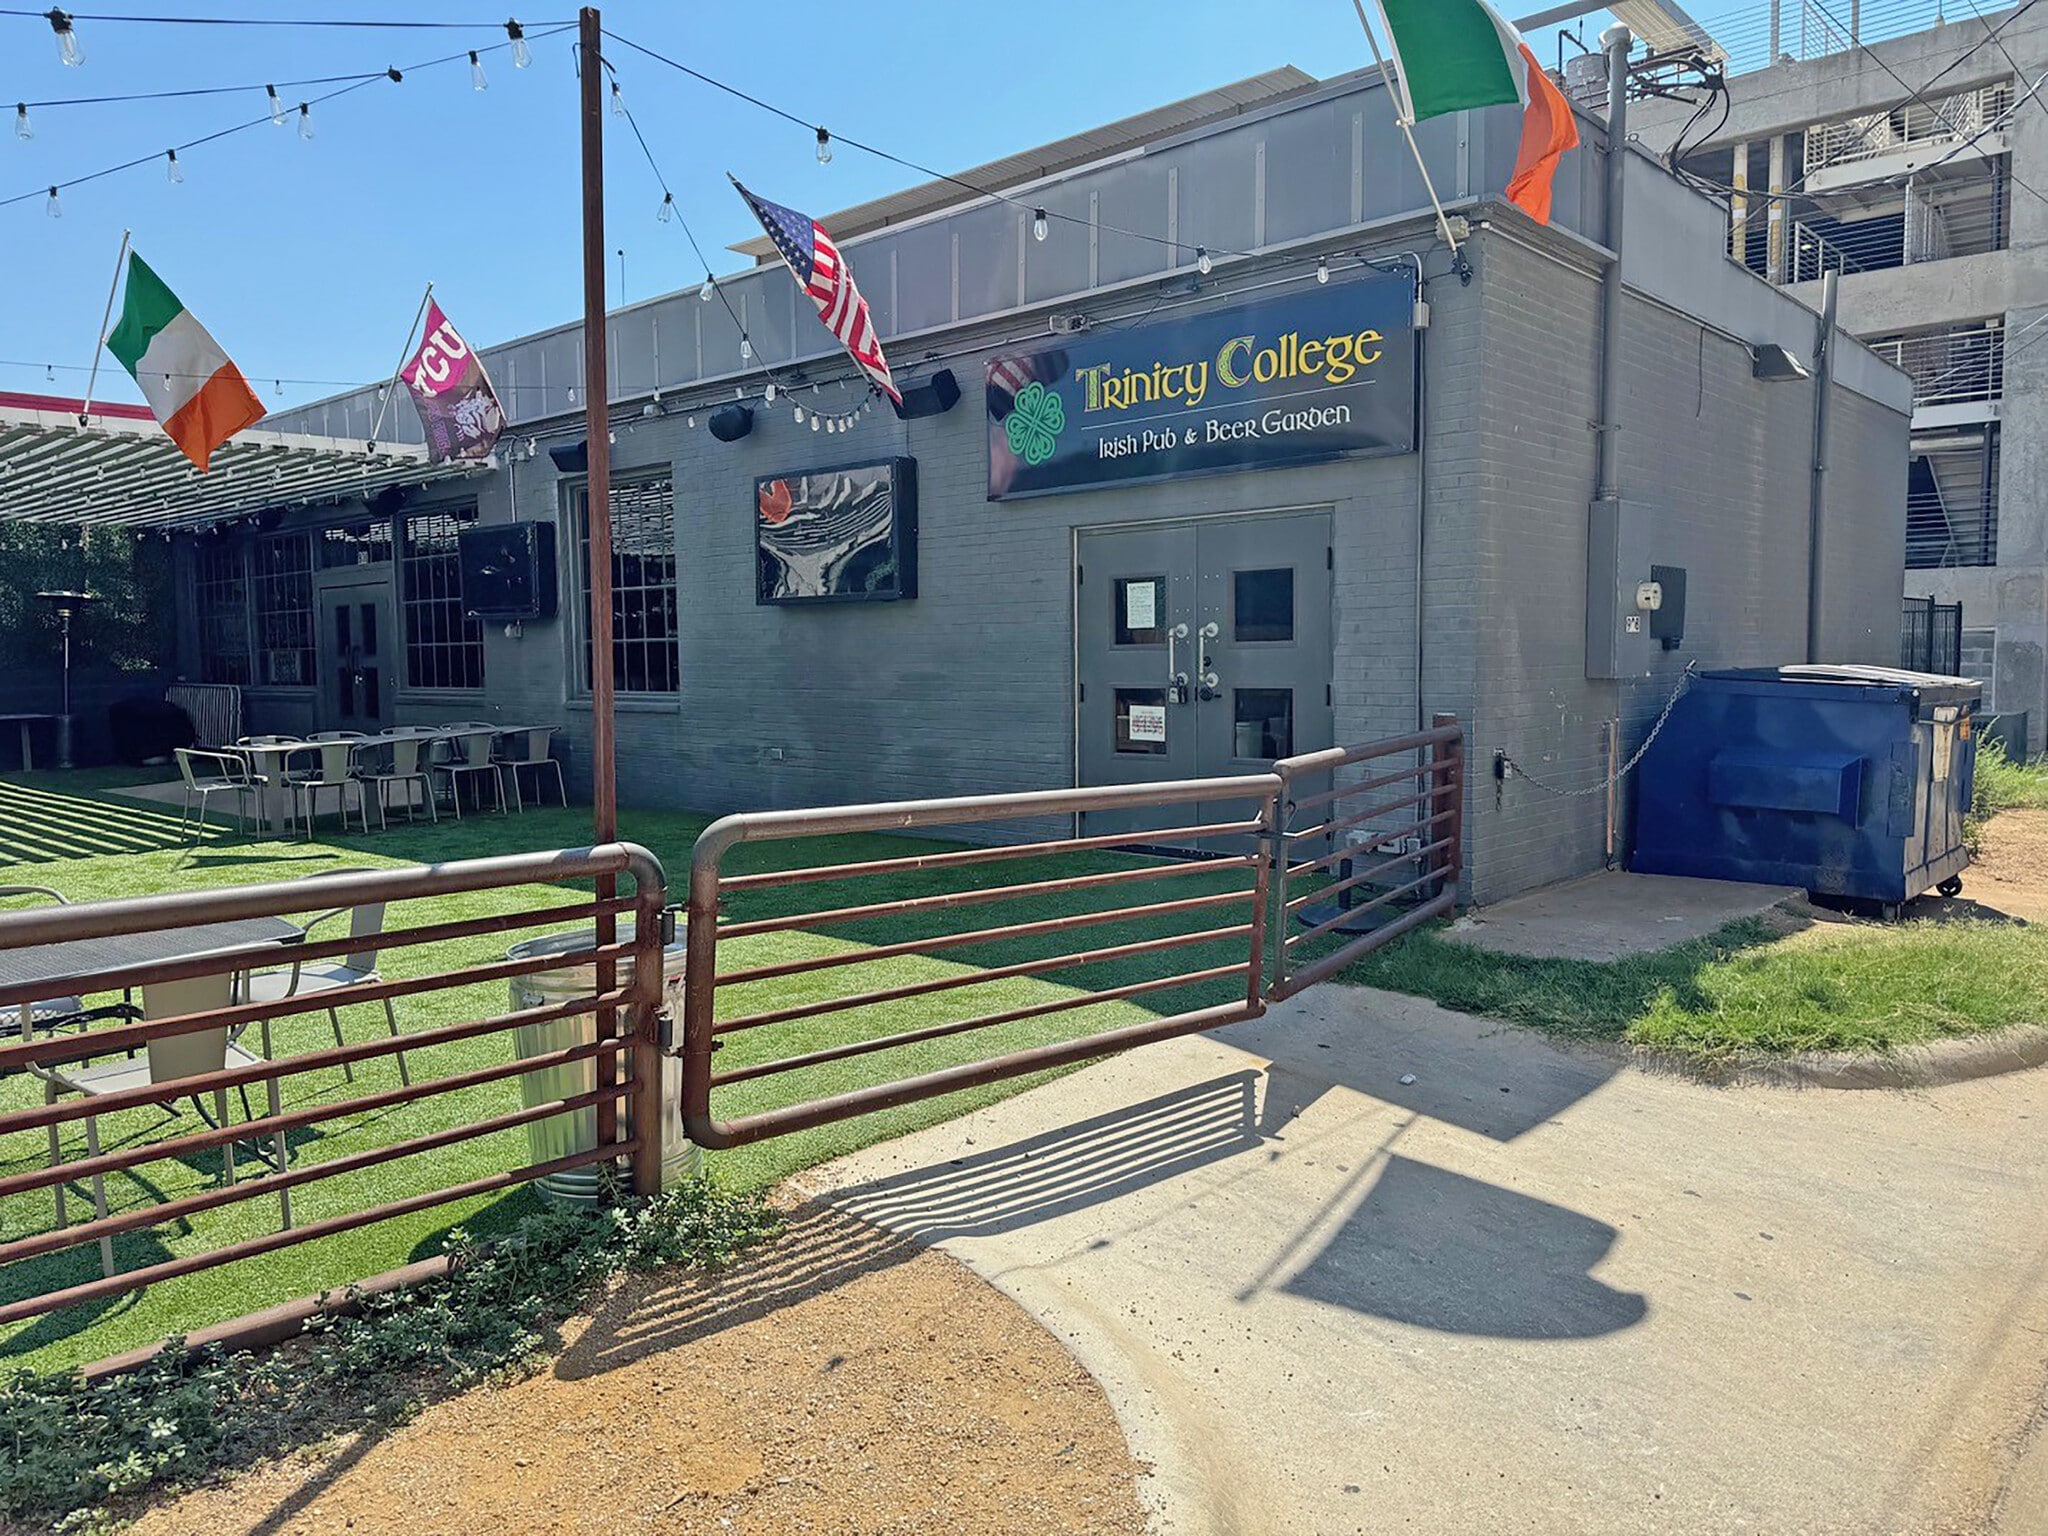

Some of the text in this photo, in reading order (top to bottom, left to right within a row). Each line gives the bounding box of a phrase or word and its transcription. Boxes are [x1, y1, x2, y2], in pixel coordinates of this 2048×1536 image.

[412, 320, 468, 398] TCU
[1075, 328, 1384, 413] Trinity College
[1099, 404, 1351, 459] Irish Pub & Beer Garden
